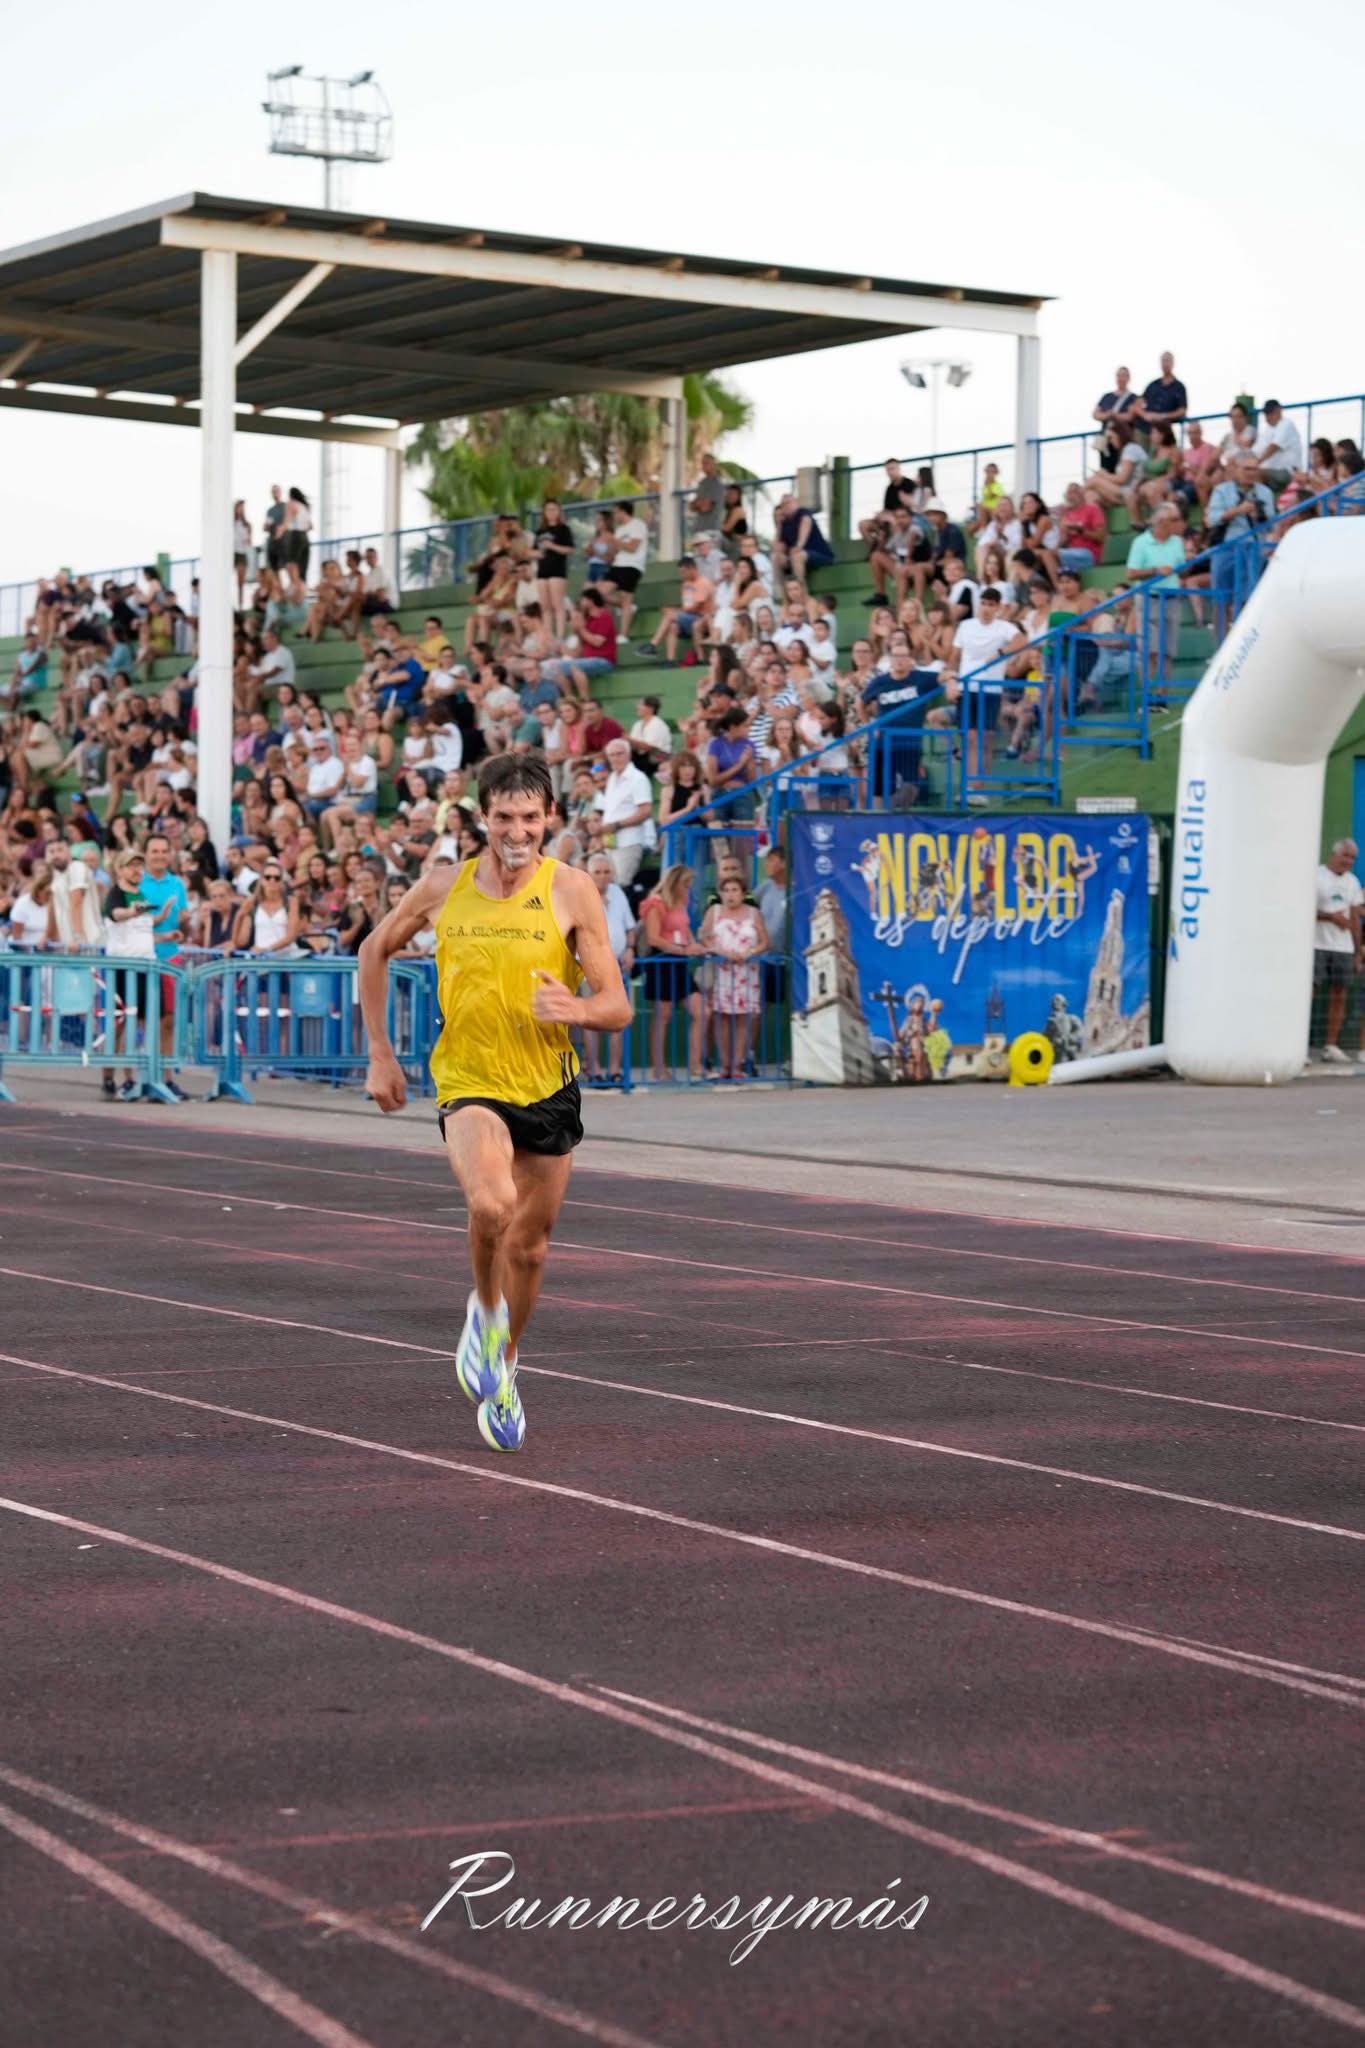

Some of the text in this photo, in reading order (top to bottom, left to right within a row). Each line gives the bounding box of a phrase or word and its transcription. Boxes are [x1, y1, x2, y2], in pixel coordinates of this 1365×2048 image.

[877, 832, 1076, 921] NOVELDA
[1179, 779, 1209, 939] aqualia
[873, 879, 1078, 985] es deporte
